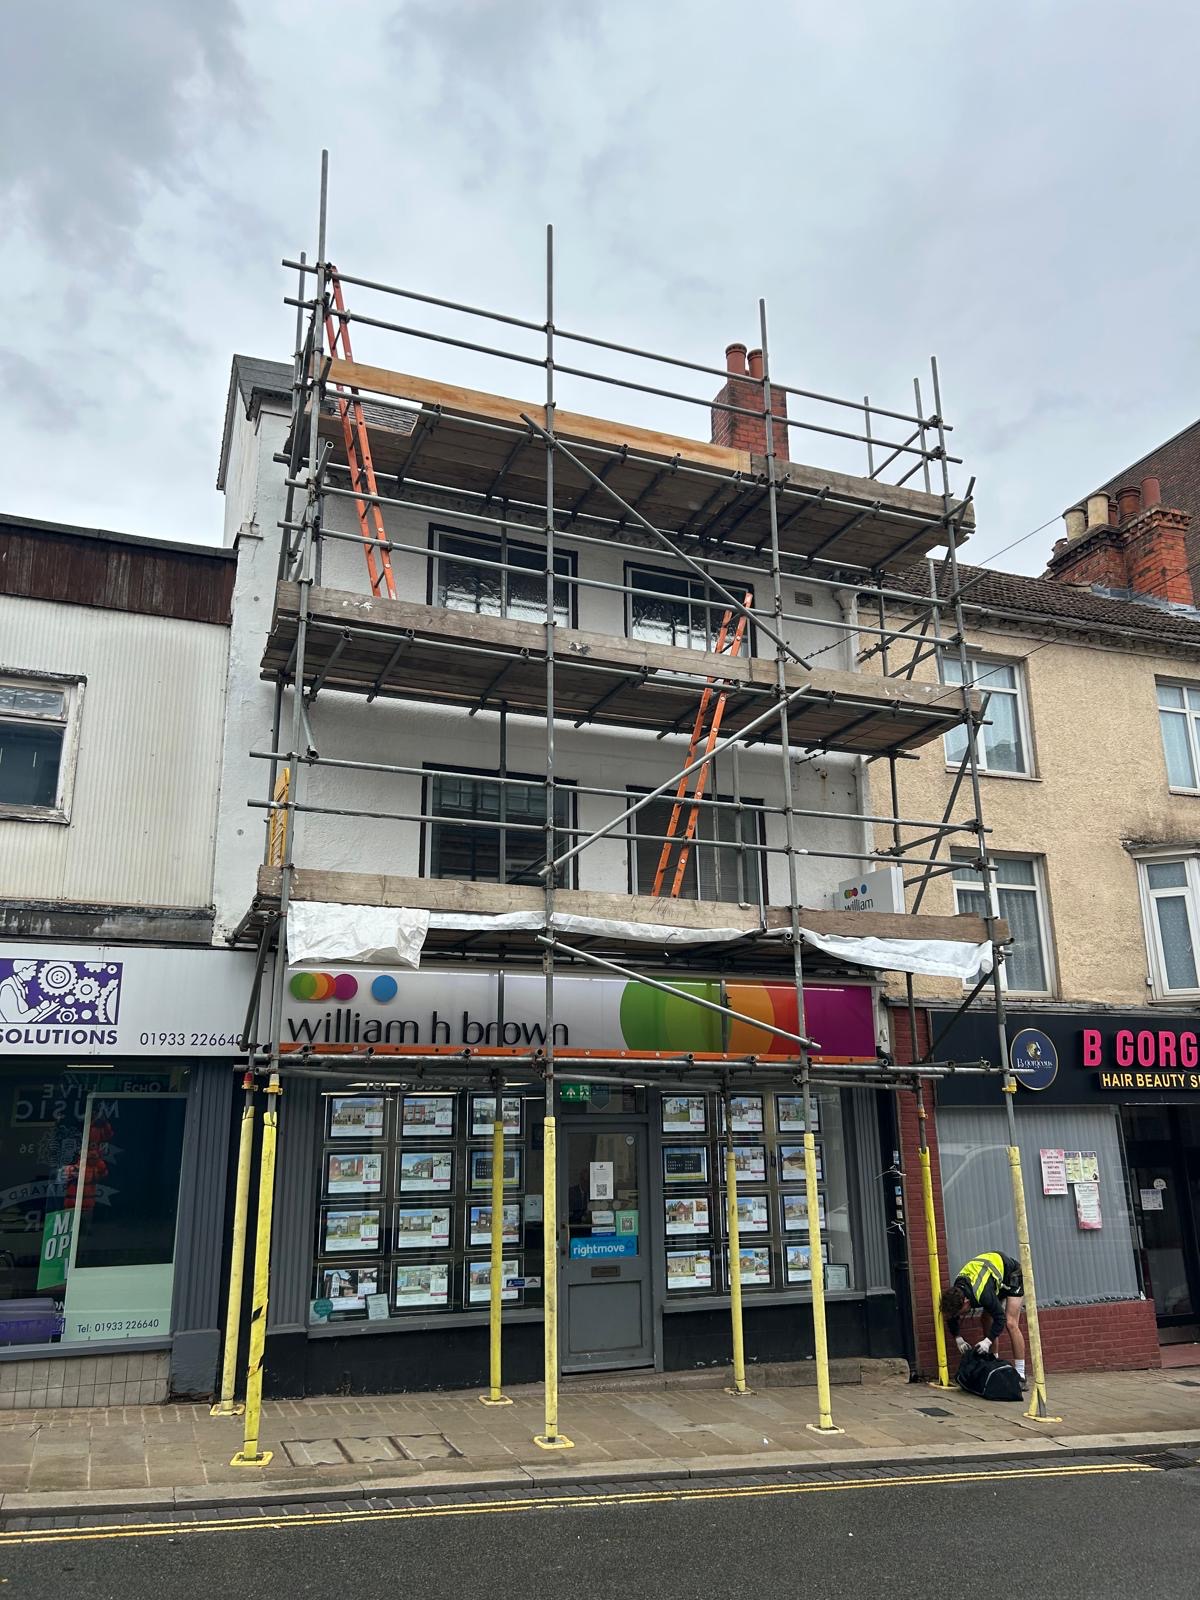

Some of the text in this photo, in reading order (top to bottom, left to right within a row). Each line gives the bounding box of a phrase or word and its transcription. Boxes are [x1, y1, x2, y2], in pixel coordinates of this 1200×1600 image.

[844, 898, 874, 911] william
[287, 1008, 569, 1046] william h brown
[140, 1032, 186, 1046] 01933
[1083, 1029, 1198, 1068] B GORG
[1102, 1073, 1200, 1088] HAIR BEAUTY S
[573, 1243, 625, 1257] rightmove
[77, 1319, 159, 1333] Tel: 01933 226640
